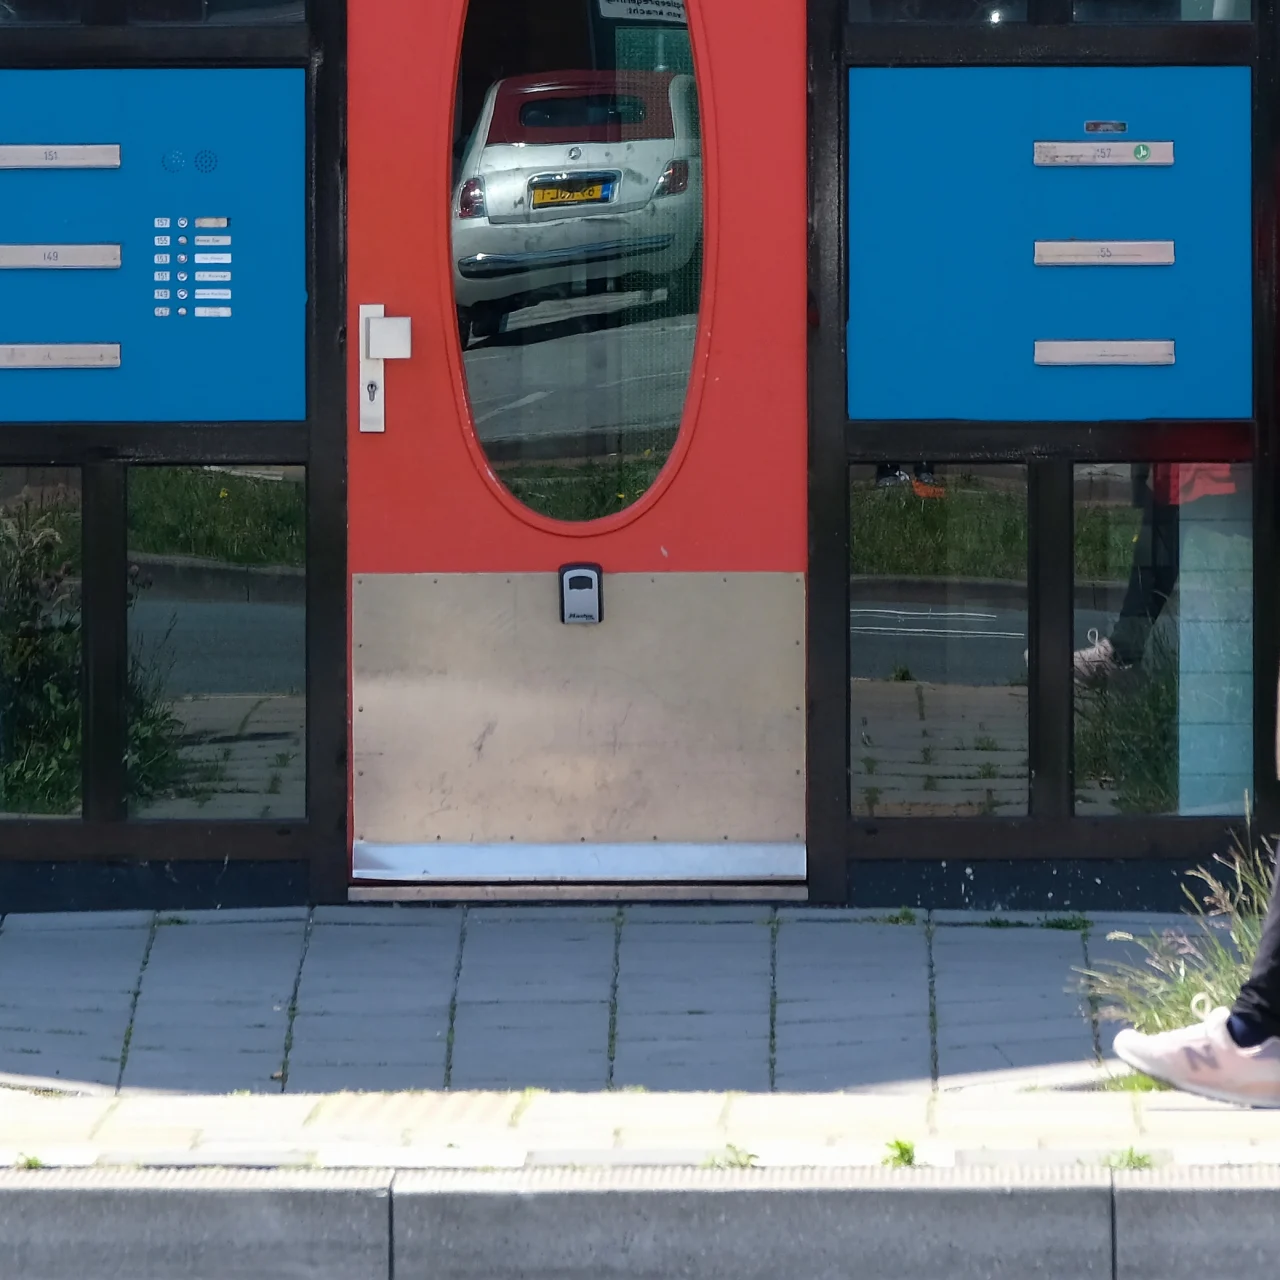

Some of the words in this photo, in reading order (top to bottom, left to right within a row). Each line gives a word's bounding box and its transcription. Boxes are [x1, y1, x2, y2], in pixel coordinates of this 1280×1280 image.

[43, 150, 59, 161] 151
[42, 250, 59, 262] 149
[1097, 247, 1113, 258] 55
